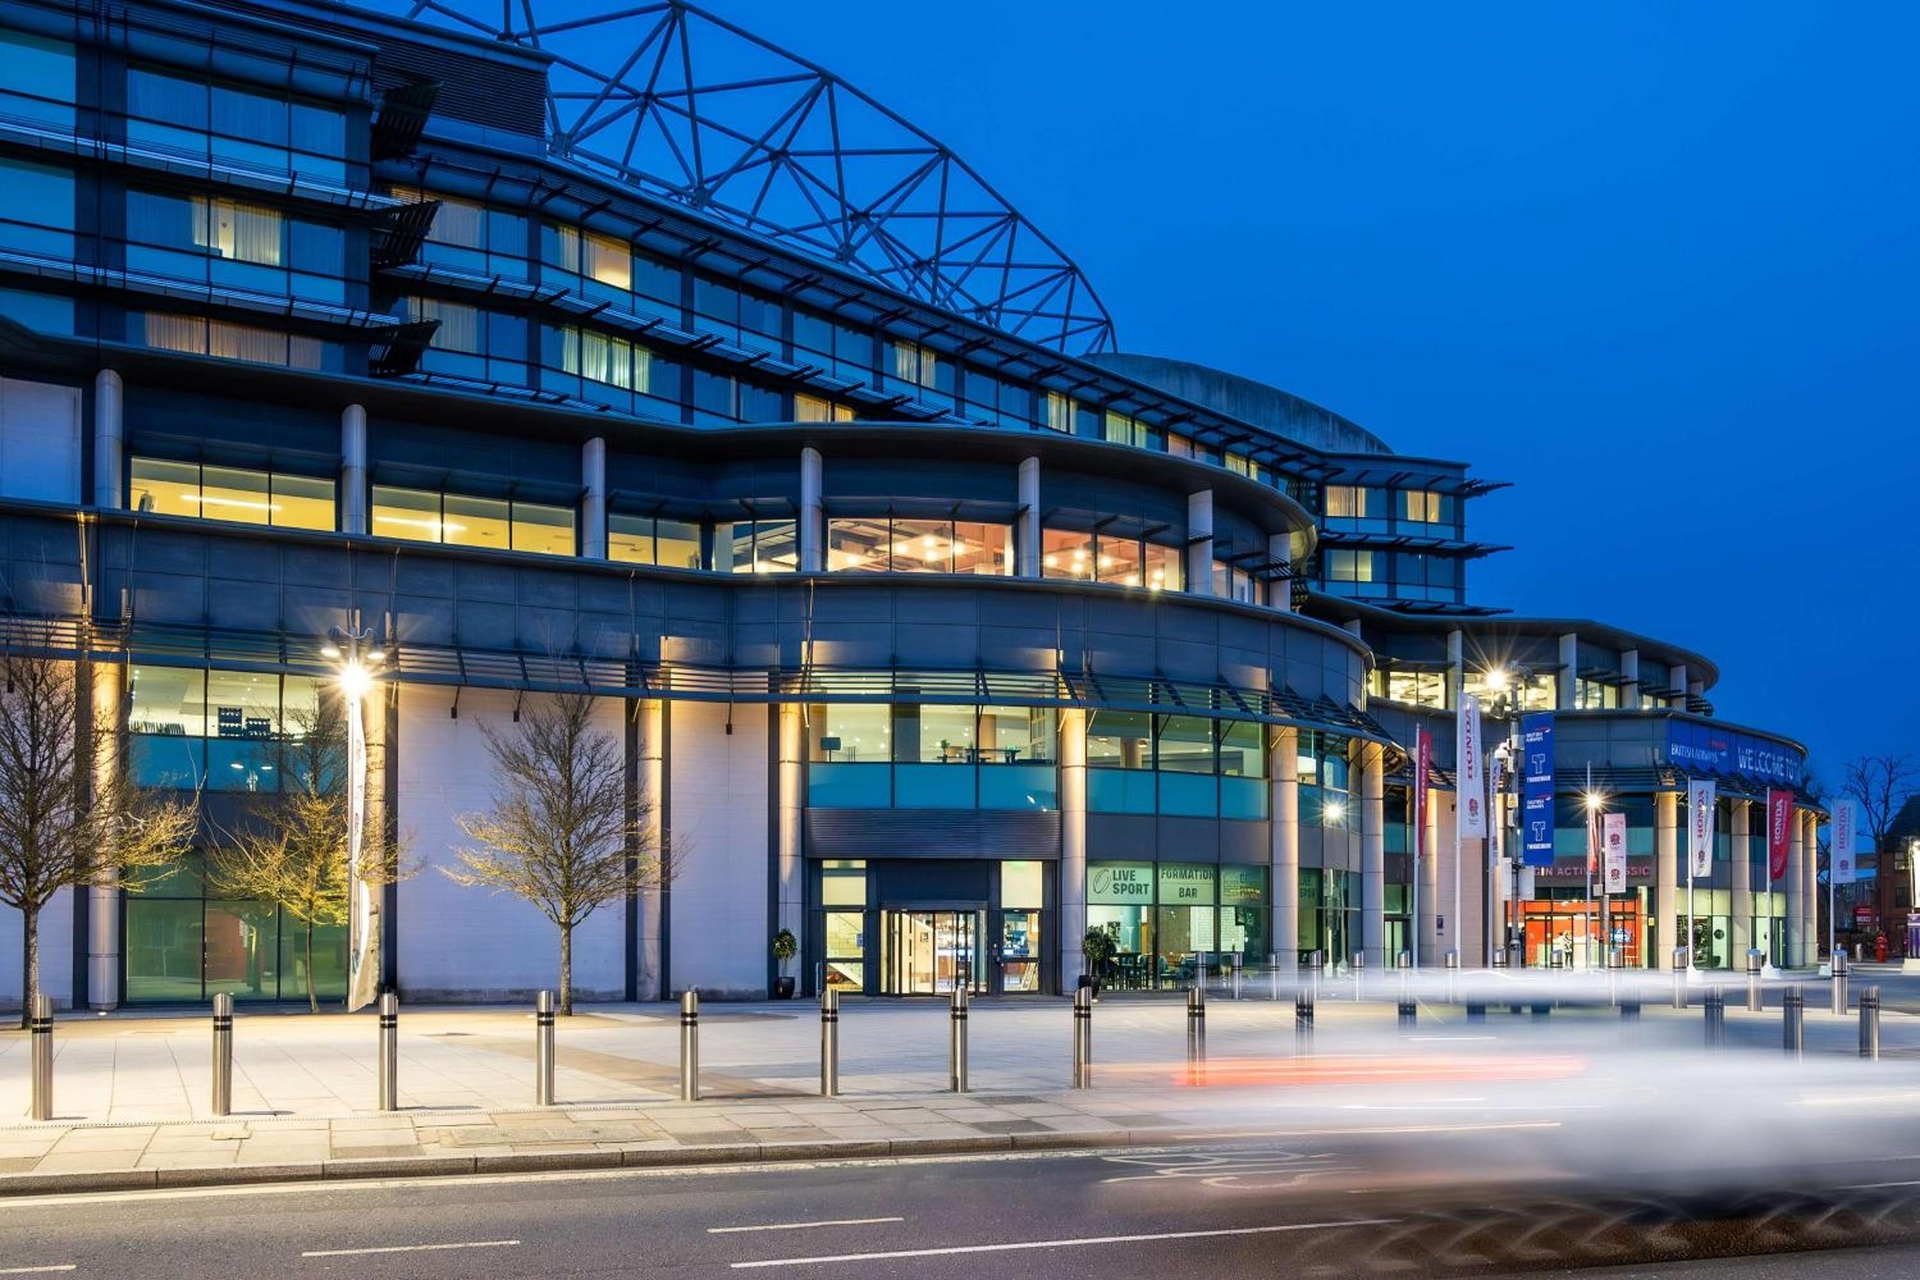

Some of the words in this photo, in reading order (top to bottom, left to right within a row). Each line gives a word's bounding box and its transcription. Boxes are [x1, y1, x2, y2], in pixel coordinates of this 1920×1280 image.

[1465, 706, 1474, 779] HONDA
[1737, 747, 1785, 777] WELCOME
[1697, 789, 1705, 839] HONDA
[1774, 798, 1784, 845] HONDA
[1838, 806, 1847, 849] HONDA
[1112, 869, 1136, 881] LIVE
[1534, 867, 1553, 876] GIN
[1625, 867, 1649, 876] SSIC
[1112, 883, 1150, 895] SPORT
[1178, 887, 1198, 898] BAR
